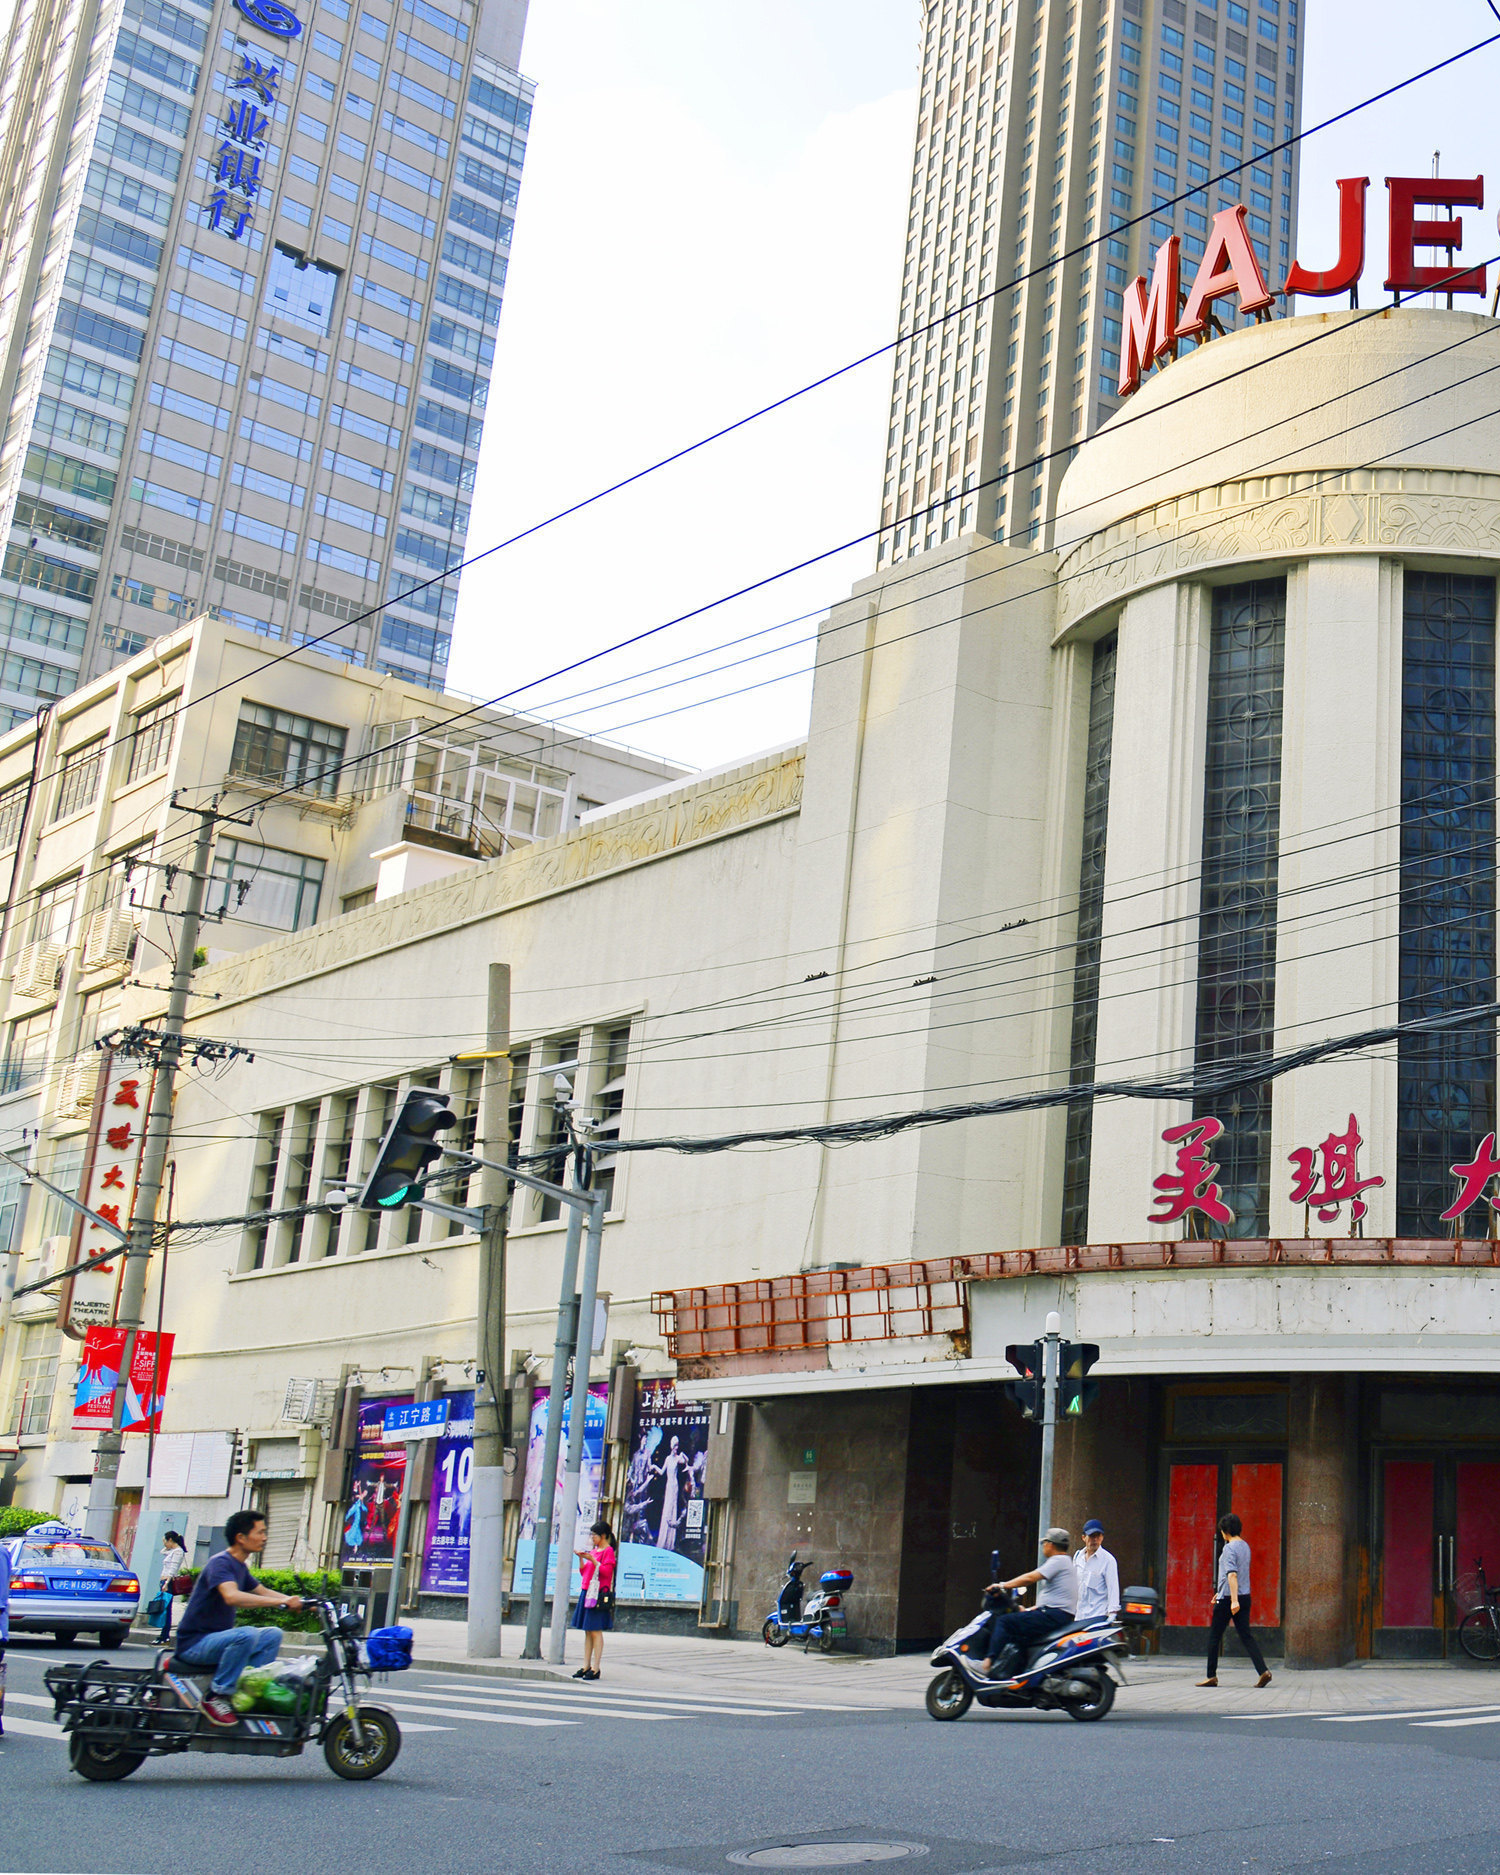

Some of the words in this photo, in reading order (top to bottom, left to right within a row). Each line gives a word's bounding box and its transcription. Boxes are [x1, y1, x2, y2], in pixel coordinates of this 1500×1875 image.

[202, 52, 281, 238] 兴业银行
[73, 1307, 109, 1316] THEATRE
[74, 1300, 111, 1309] MAJESTIC
[398, 1405, 431, 1426] 江宁路
